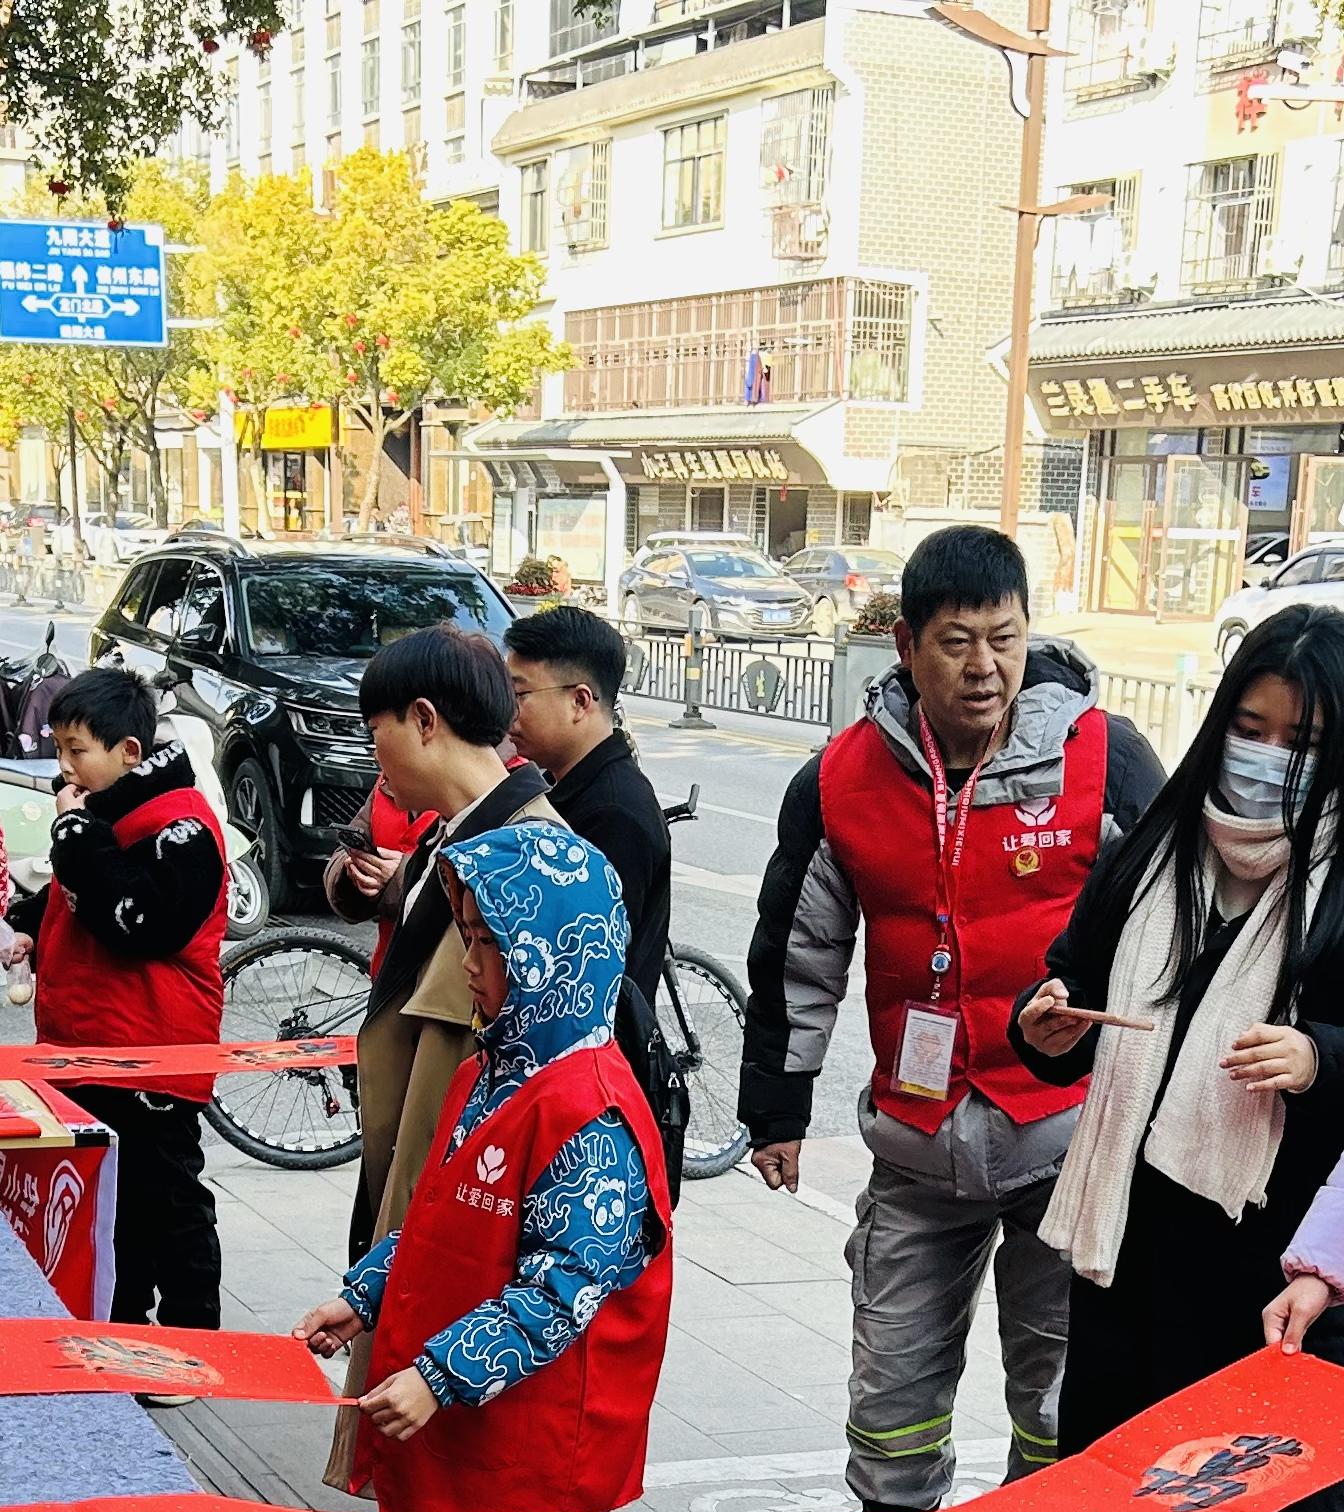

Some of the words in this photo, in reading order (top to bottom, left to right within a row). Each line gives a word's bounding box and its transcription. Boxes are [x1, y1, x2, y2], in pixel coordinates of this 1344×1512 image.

[1001, 828, 1073, 853] 让爱回家
[549, 1131, 618, 1183] ANTA
[455, 1181, 515, 1218] 让爱回家
